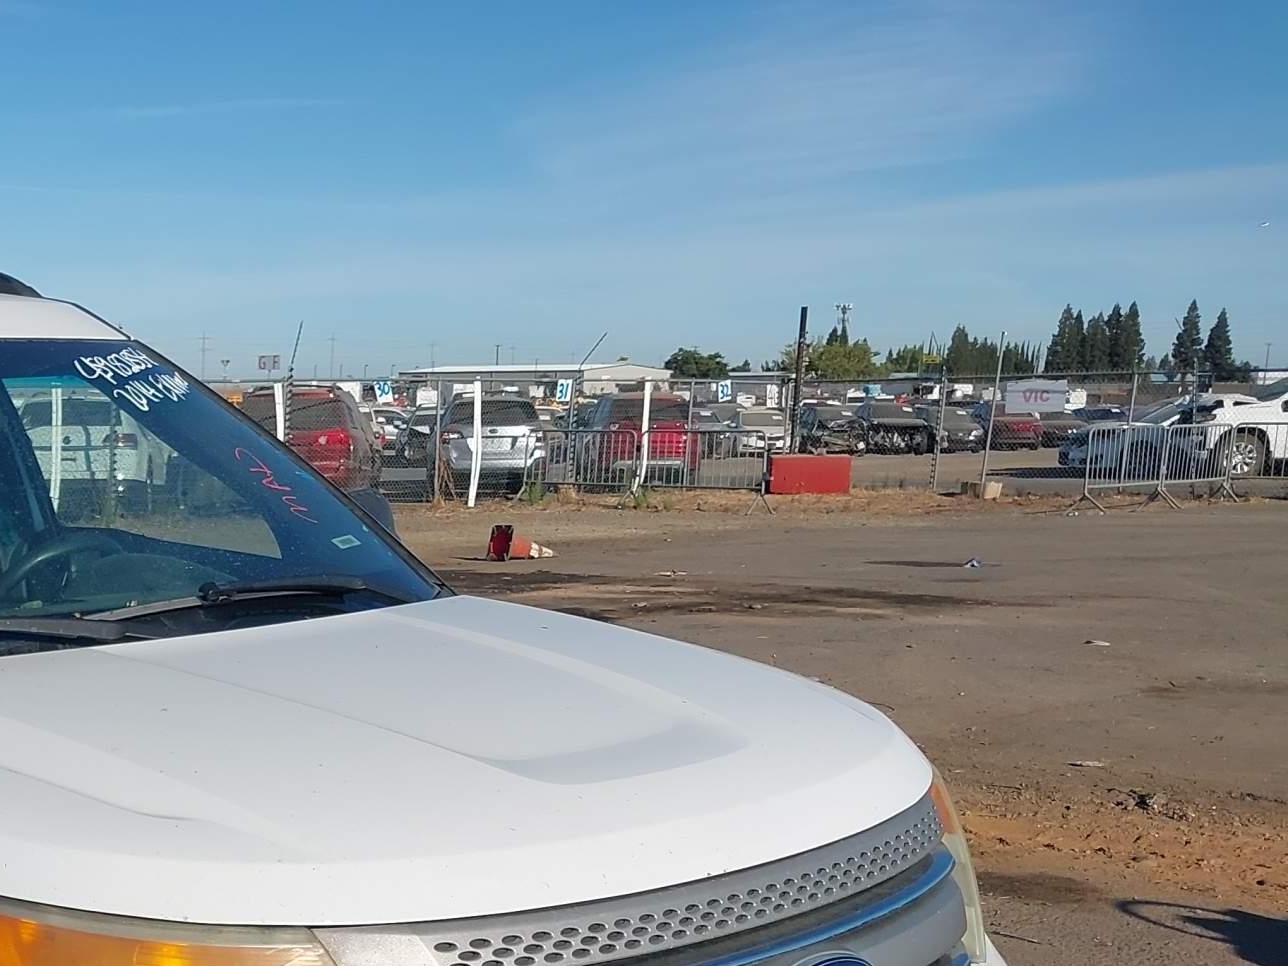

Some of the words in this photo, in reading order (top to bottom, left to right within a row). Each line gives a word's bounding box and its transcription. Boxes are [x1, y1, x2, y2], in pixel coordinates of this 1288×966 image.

[113, 380, 164, 412] 2014
[376, 381, 390, 398] 30
[558, 383, 569, 400] 31
[719, 383, 732, 400] 32
[1023, 389, 1049, 403] VIC
